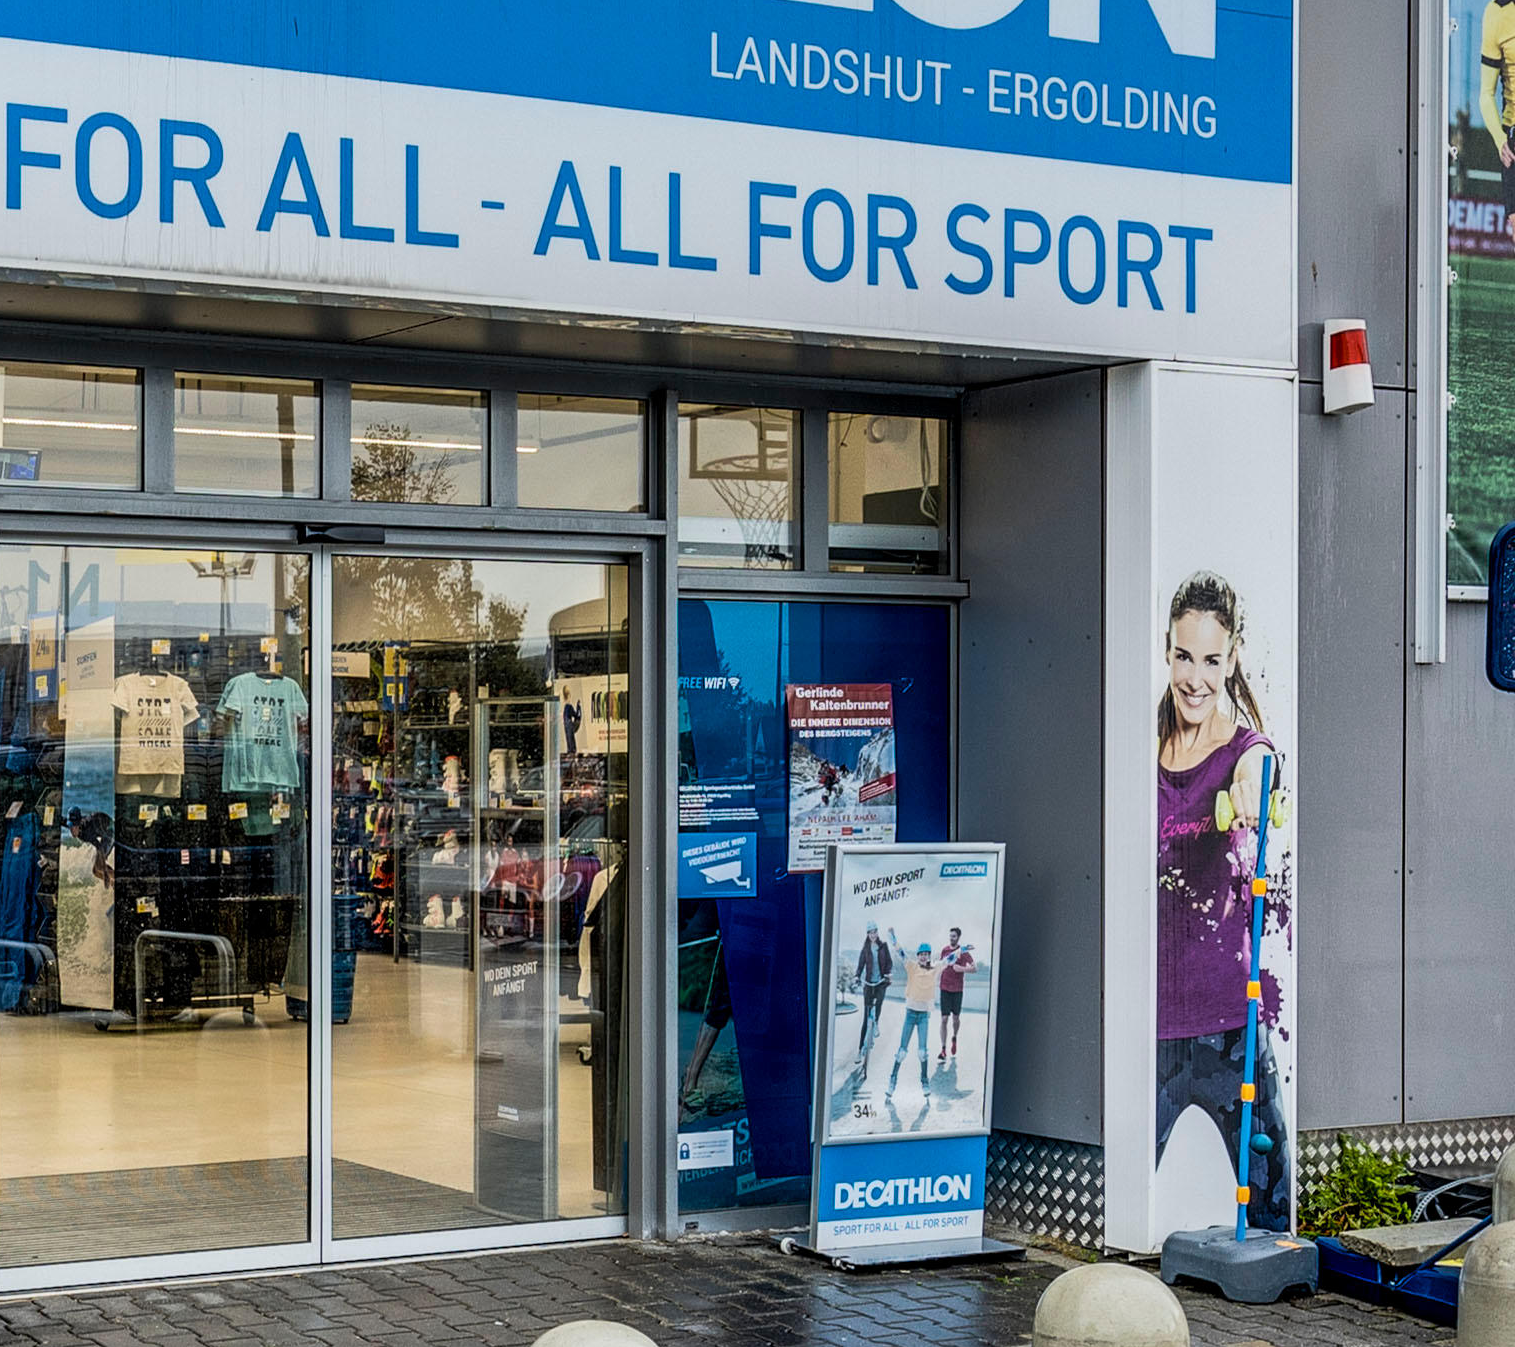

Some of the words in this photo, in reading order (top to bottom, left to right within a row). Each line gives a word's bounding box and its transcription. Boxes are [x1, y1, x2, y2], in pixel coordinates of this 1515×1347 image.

[711, 32, 951, 106] LANDSHUT
[989, 69, 1217, 138] ERGOLDING
[6, 102, 225, 229] FOR
[255, 132, 460, 249] ALL
[533, 160, 718, 271] ALL
[749, 180, 919, 290] FOR
[944, 203, 1214, 314] SPORT
[678, 677, 702, 689] FREE
[704, 676, 727, 690] WIFI
[795, 687, 844, 698] Gerlinde
[810, 700, 890, 711] Kaltenbrunner
[790, 718, 807, 727] DIE
[808, 717, 841, 727] INNERE
[843, 717, 892, 726] DIMENSION
[799, 729, 815, 738] DES
[815, 729, 872, 737] BERGSTEIGENS
[853, 881, 868, 895] WO
[870, 876, 893, 891] DEIN
[894, 868, 925, 885] SPORT
[484, 969, 494, 982] WO
[495, 965, 511, 981] DEIN
[512, 961, 538, 977] SPORT
[853, 1103, 870, 1119] 34
[834, 1173, 971, 1211] DECATHLON
[833, 1225, 862, 1236] SPORT
[864, 1223, 881, 1233] FOR
[883, 1221, 899, 1231] ALL
[905, 1220, 921, 1230] ALL
[923, 1217, 940, 1228] FOR
[941, 1215, 969, 1228] SPORT
